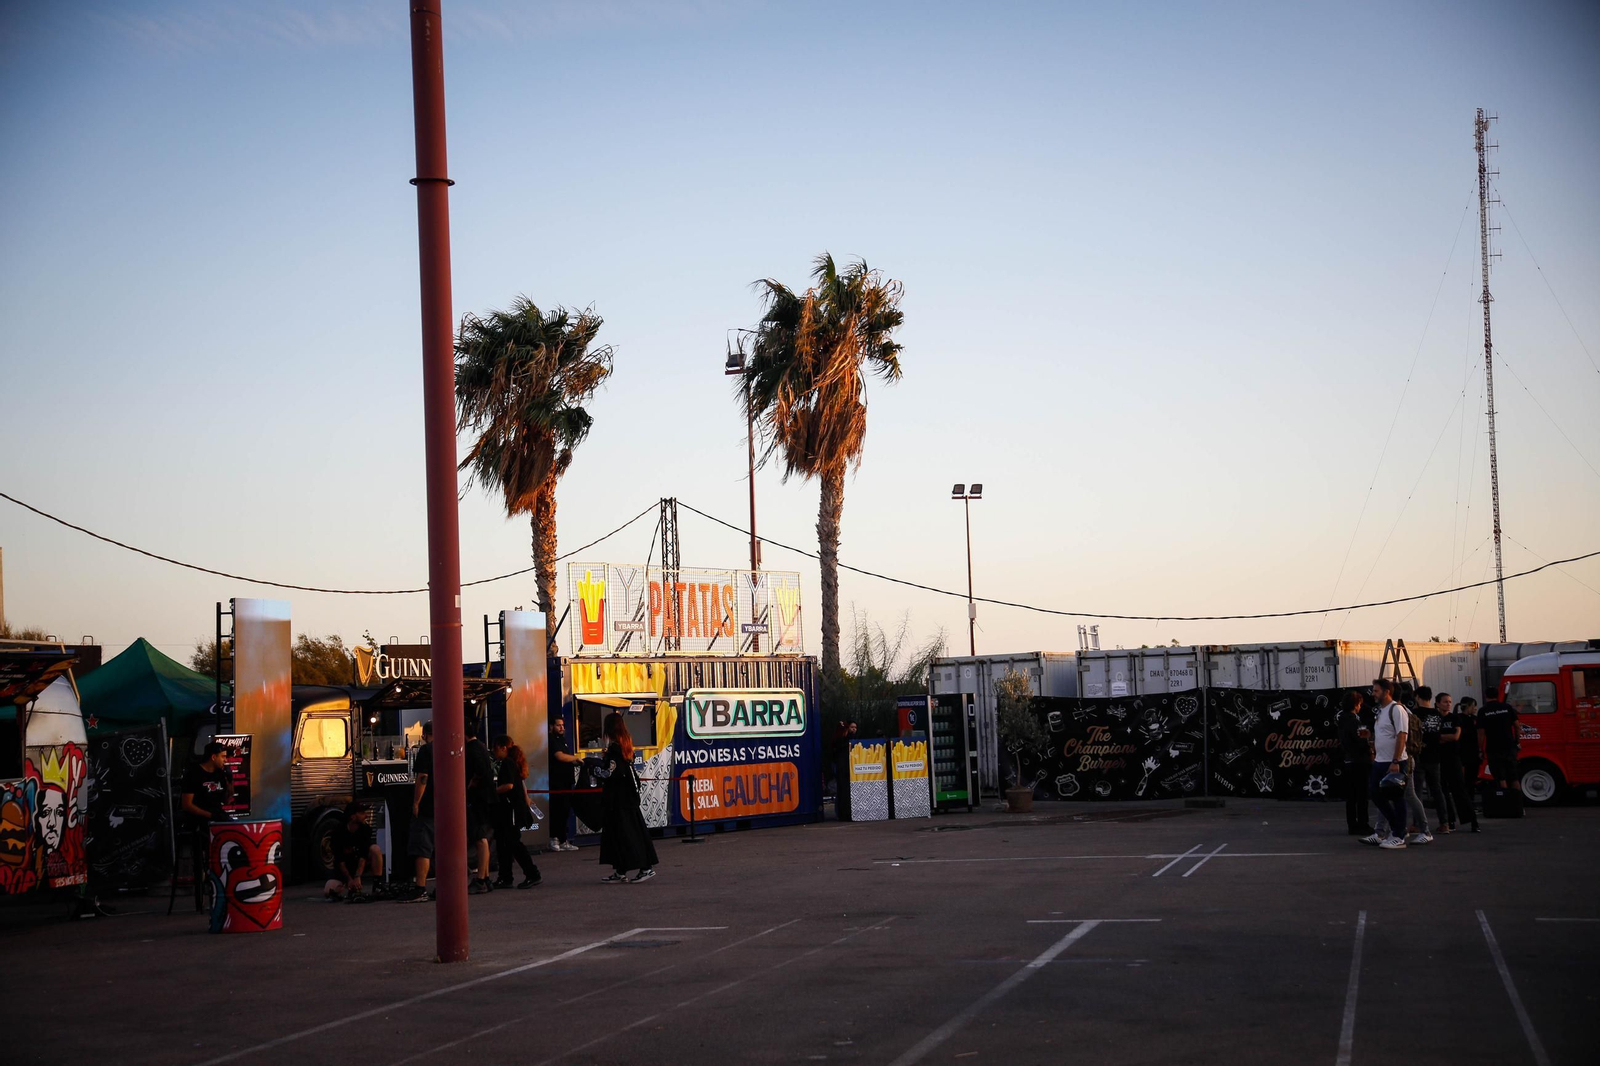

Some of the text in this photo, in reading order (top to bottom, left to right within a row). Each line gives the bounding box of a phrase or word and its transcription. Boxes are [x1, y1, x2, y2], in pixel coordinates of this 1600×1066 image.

[650, 581, 735, 637] PATATAS
[375, 653, 432, 679] GUINN
[1304, 666, 1324, 674] 870814
[693, 699, 803, 728] YBARRA
[1086, 725, 1112, 745] The
[1286, 718, 1314, 739] The
[1063, 737, 1137, 758] Champions
[1264, 732, 1339, 753] Champions
[674, 747, 746, 764] MAYONESAS
[747, 747, 757, 760] Y
[757, 744, 801, 759] SALSAS
[1076, 754, 1127, 774] Burger
[1278, 749, 1330, 771] Burger
[377, 772, 409, 784] GUINNESS
[697, 794, 720, 809] SALSA
